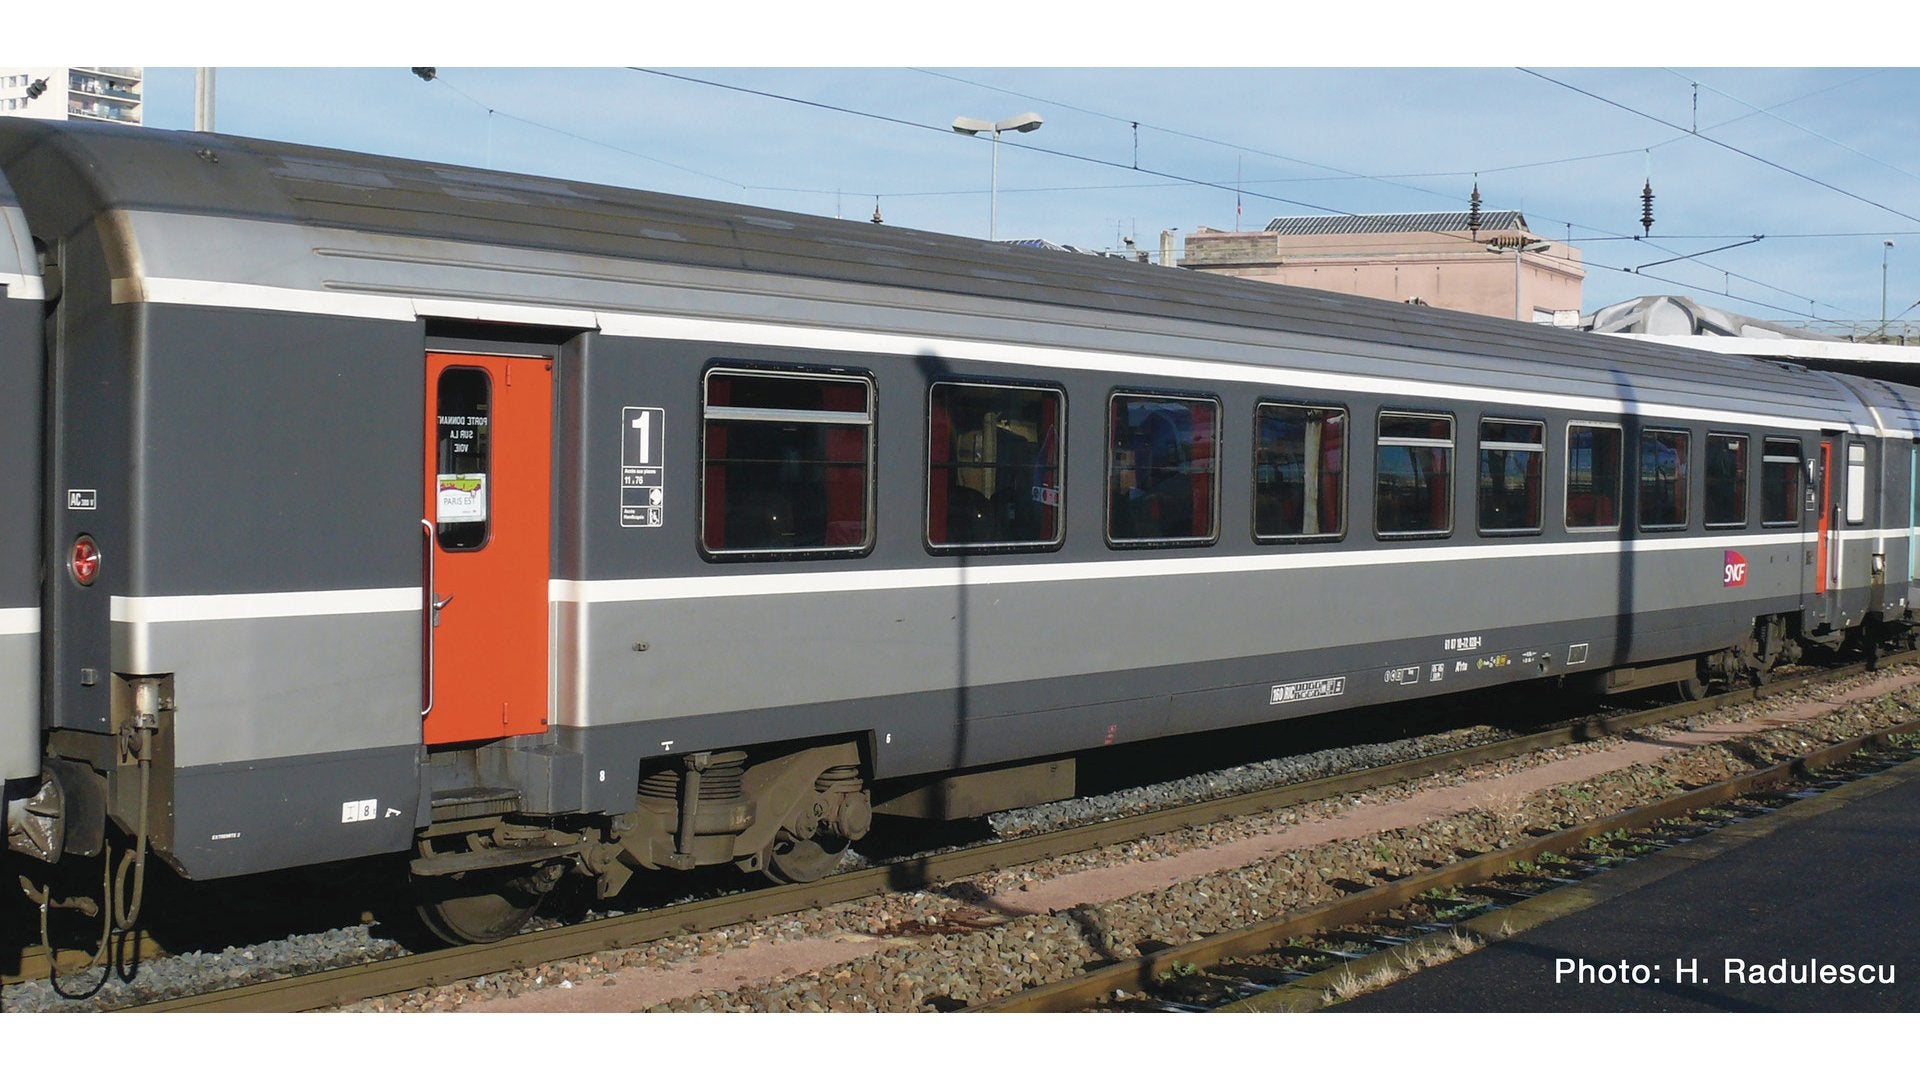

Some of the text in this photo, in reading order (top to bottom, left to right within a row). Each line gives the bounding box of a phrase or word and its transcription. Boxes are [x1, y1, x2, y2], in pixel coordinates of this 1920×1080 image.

[632, 411, 649, 464] 1
[624, 475, 631, 485] 11
[70, 492, 81, 507] AC
[443, 497, 463, 506] PARIS
[1724, 563, 1746, 583] SNCF
[885, 733, 891, 744] 6
[599, 769, 606, 782] 8
